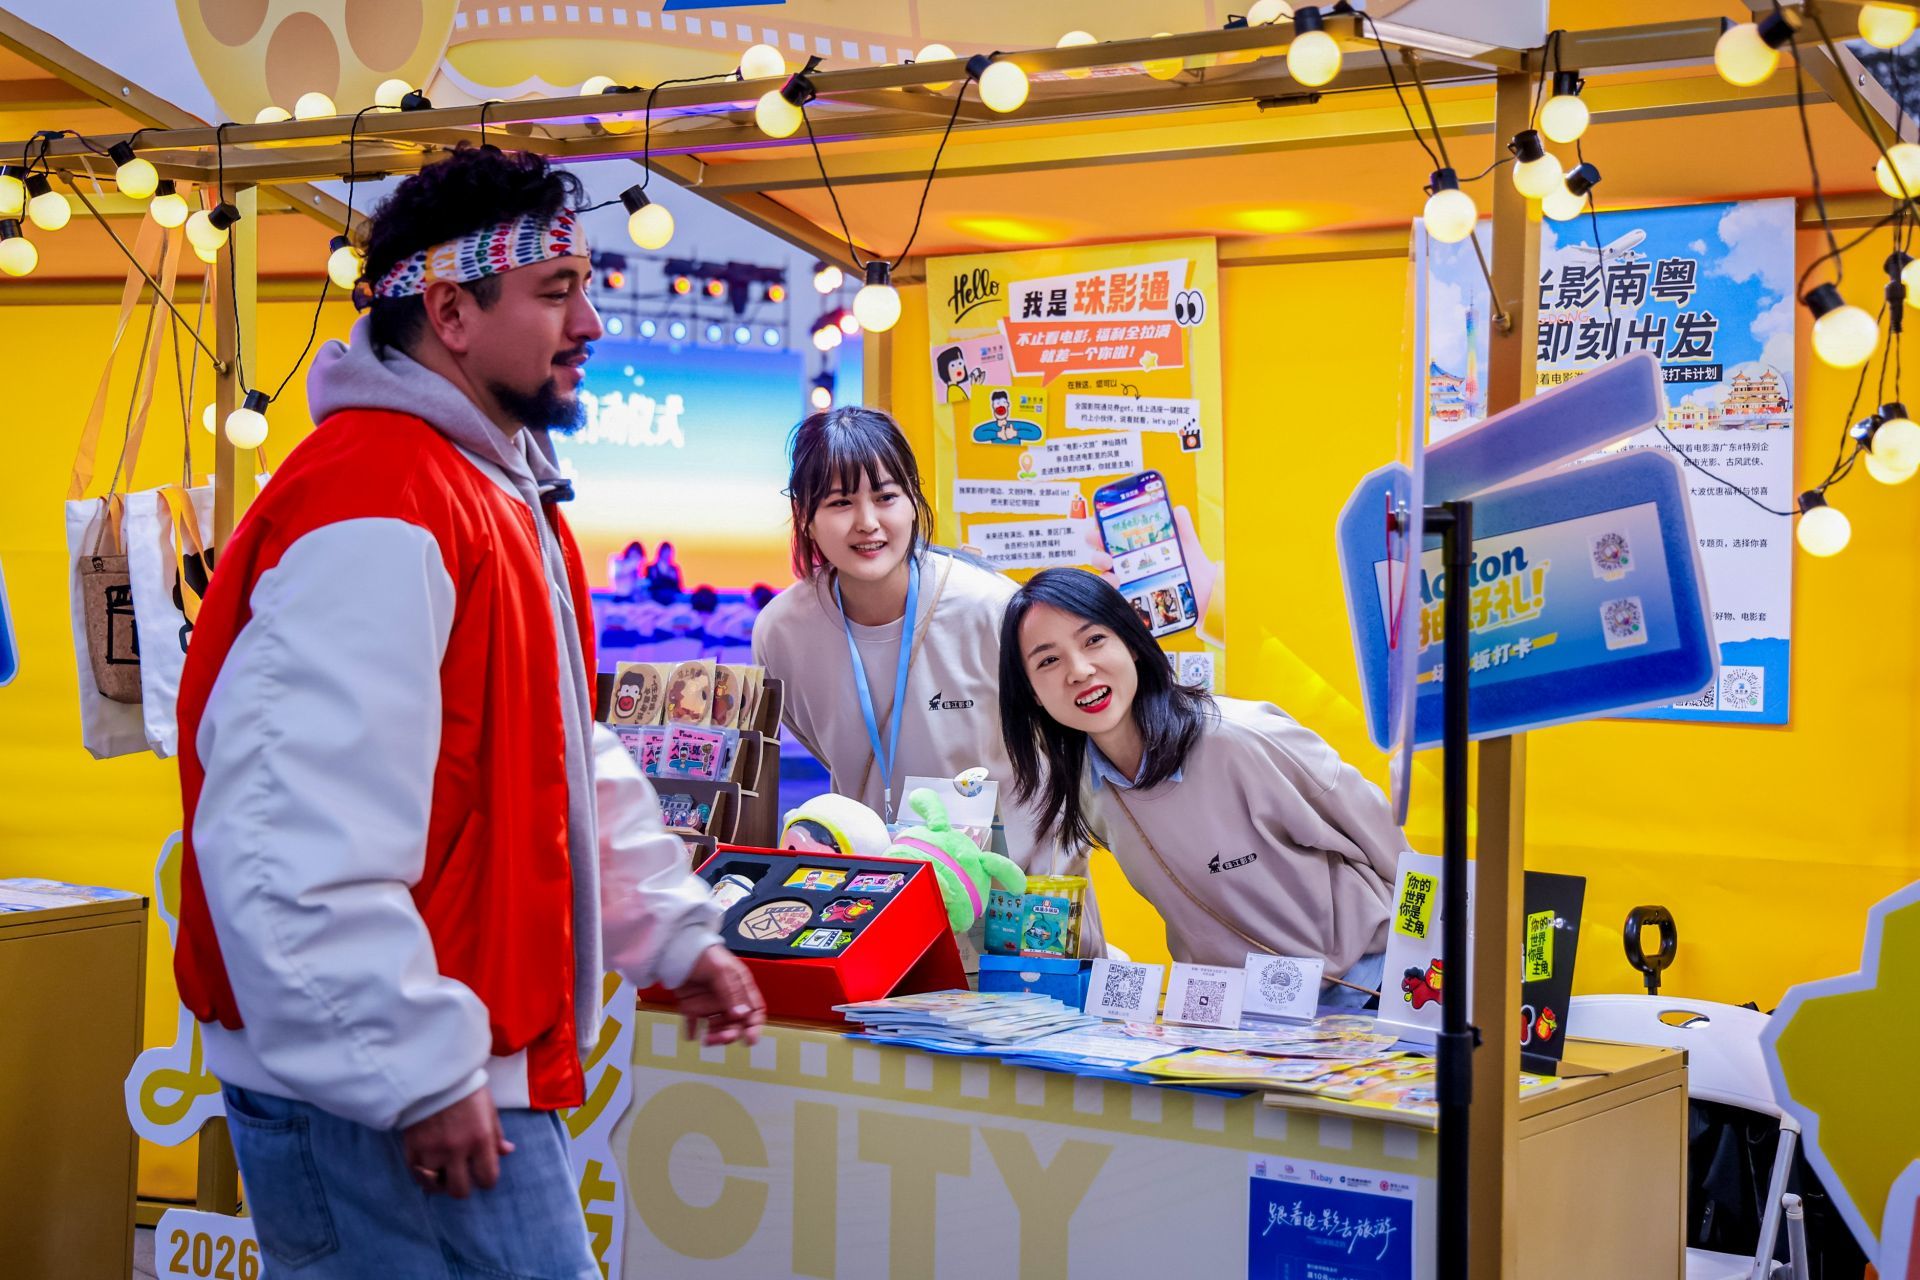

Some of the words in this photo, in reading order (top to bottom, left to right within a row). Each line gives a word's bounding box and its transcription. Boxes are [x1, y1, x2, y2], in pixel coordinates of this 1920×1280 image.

[948, 268, 1001, 316] Hello
[1537, 312, 1718, 363] 即刻出发
[1713, 611, 1767, 621] 好物、电影套
[1400, 903, 1420, 919] 你是
[1405, 890, 1426, 906] 世界
[627, 1081, 1113, 1280] CITY
[169, 1229, 259, 1280] 2026
